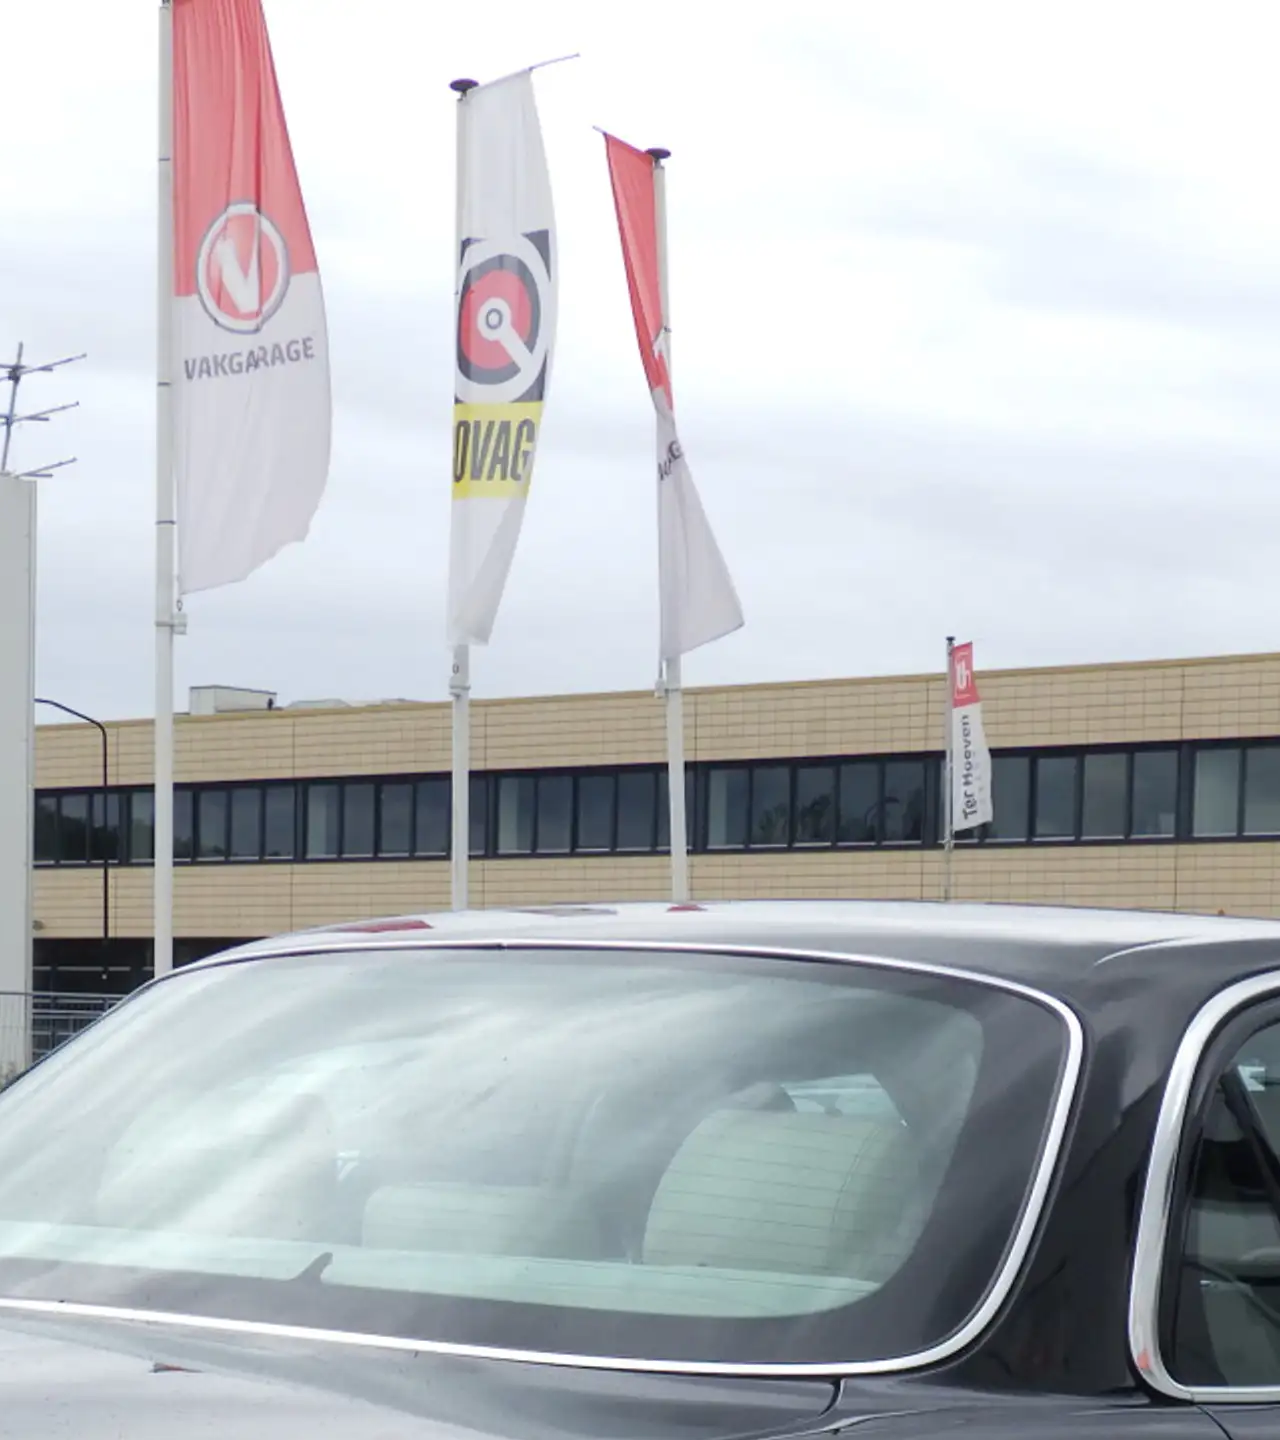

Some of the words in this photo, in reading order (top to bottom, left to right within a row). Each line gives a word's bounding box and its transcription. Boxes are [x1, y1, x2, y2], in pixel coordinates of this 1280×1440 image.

[184, 336, 315, 381] VAKGARAGE
[961, 714, 973, 787] Hoeven
[962, 790, 978, 820] Ter
